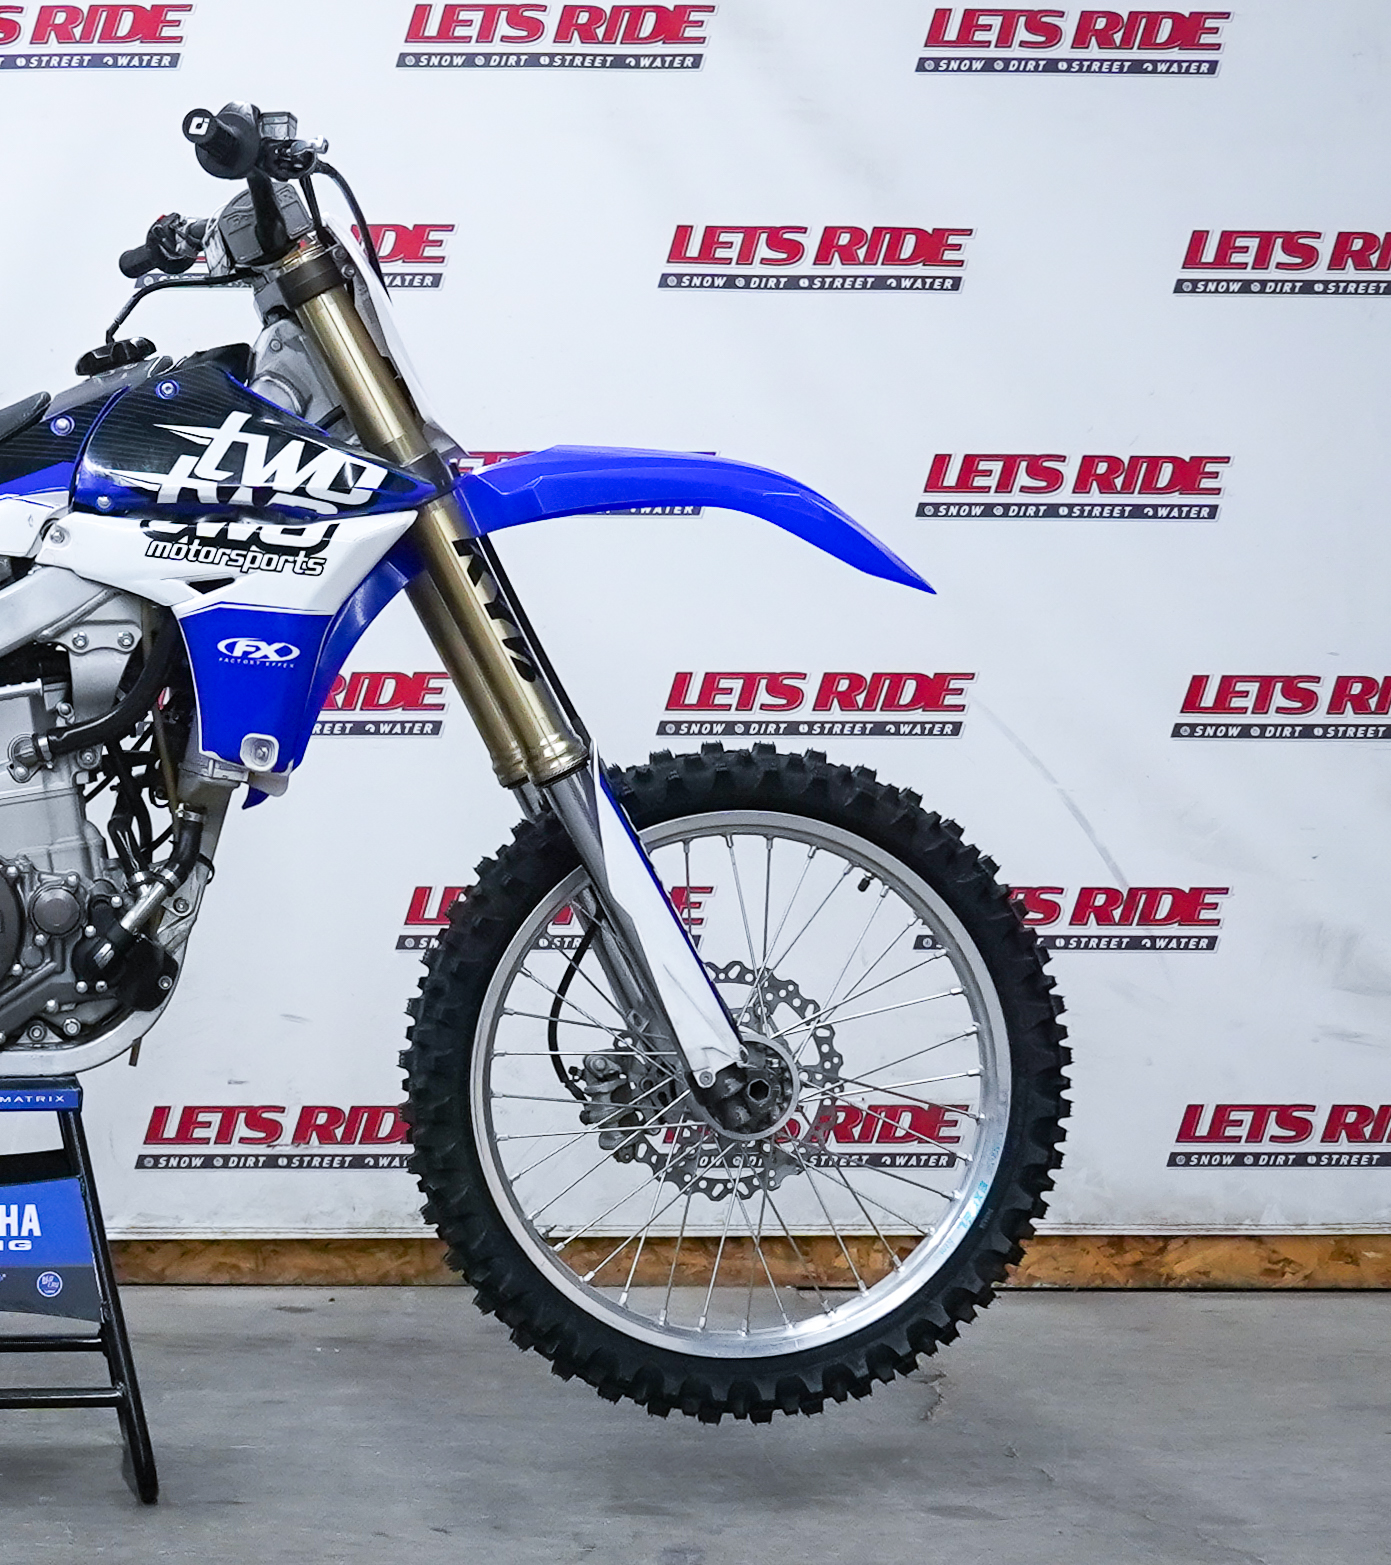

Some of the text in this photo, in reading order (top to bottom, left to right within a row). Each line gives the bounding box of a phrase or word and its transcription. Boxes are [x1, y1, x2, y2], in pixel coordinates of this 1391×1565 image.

[30, 5, 192, 44] RIDE
[405, 4, 715, 44] LETS RIDE
[924, 9, 1232, 50] LETS RIDE
[28, 56, 92, 68] STREET
[117, 55, 171, 68] WATER
[418, 54, 694, 68] SNOW DIRT STREET WATER
[937, 59, 1210, 74] SNOW DIRT STREET WATER
[666, 226, 974, 267] LETS RIDE
[1181, 231, 1391, 272] LETS RI
[679, 276, 952, 291] SNOW DIRT STREET WATER
[1194, 281, 1389, 295] SNOW DIRT STREET
[924, 454, 1232, 495] LETS RIDE
[937, 504, 1210, 519] SNOW DIRT STREET WATER
[145, 539, 327, 576] motorsports
[665, 672, 975, 712] LETS RIDE
[1182, 675, 1391, 716] LETS RI
[311, 722, 433, 735] REET WATER
[678, 722, 954, 736] SNOW DIRT STREET WATER
[1194, 724, 1387, 738] SNOW DIRT STREET
[1070, 886, 1231, 926] RIDE
[1068, 937, 1209, 950] STREET WATER
[0, 1095, 65, 1103] MATRIX
[144, 1105, 411, 1145] LETS RID
[1176, 1104, 1391, 1145] LETS RI
[157, 1156, 205, 1168] SNOW
[227, 1155, 268, 1168] DIRT
[290, 1156, 354, 1168] STREET
[895, 1155, 948, 1167] WATER
[1188, 1153, 1381, 1167] SNOW DIRT STREET
